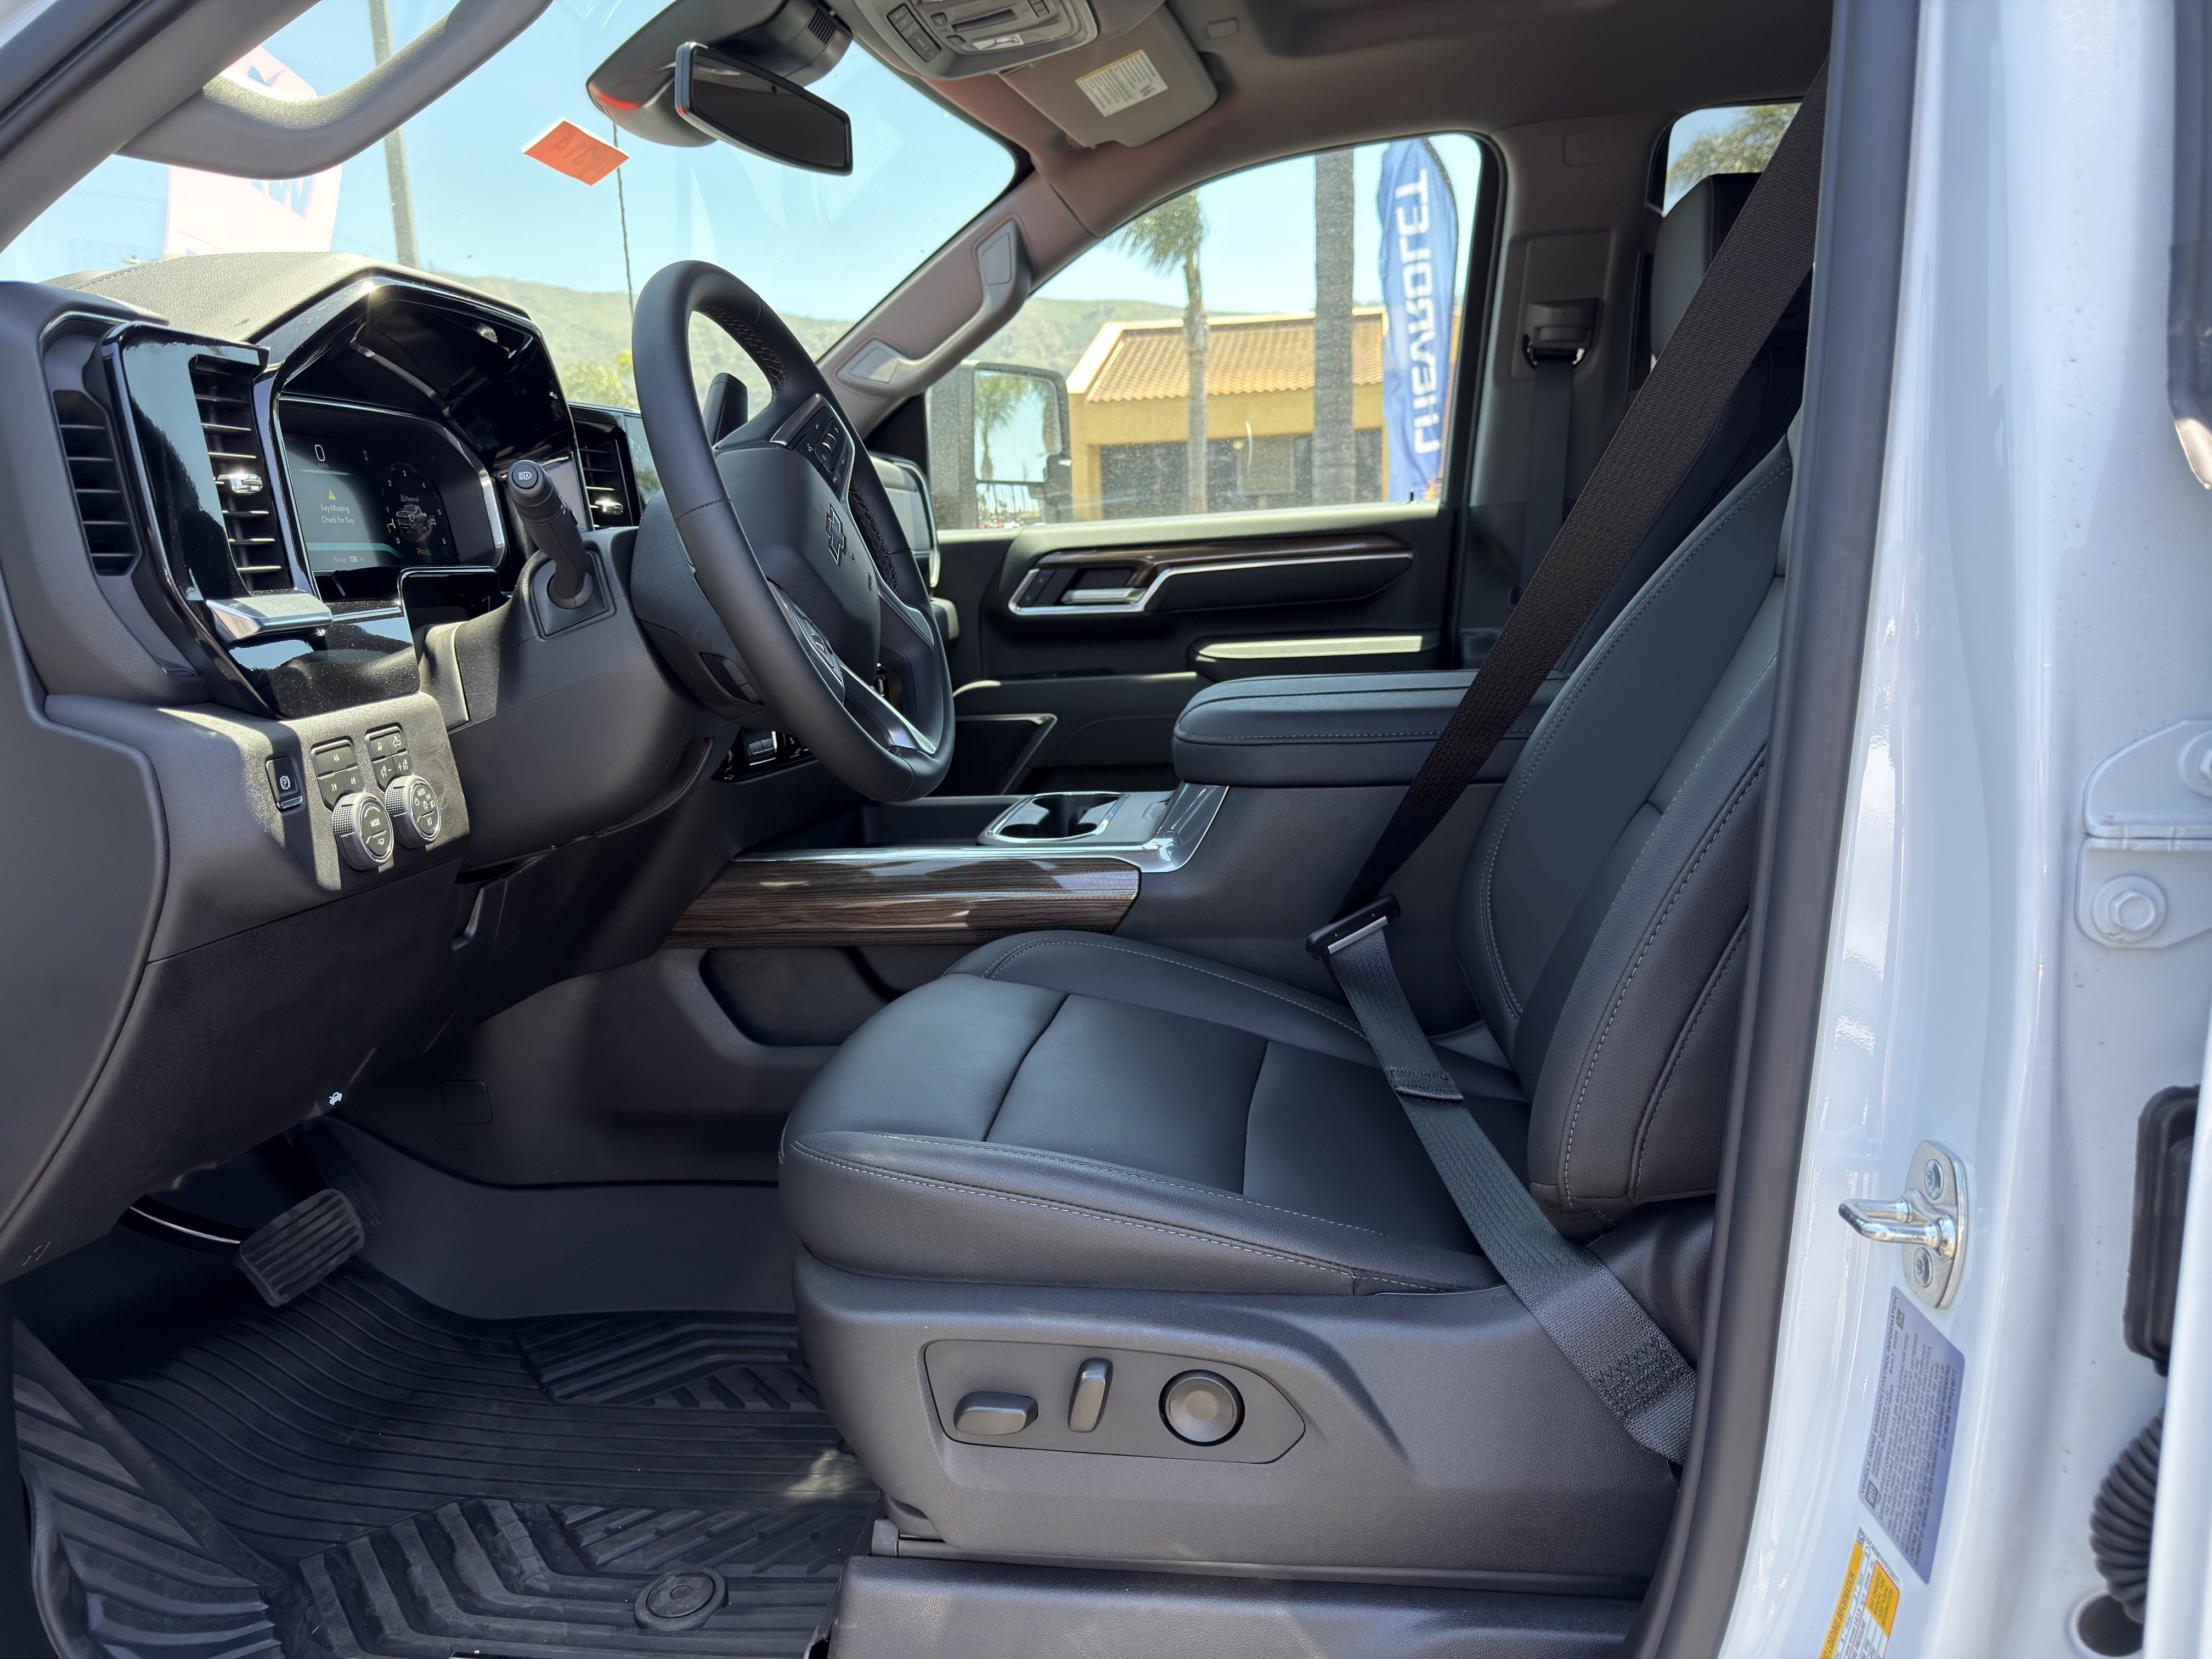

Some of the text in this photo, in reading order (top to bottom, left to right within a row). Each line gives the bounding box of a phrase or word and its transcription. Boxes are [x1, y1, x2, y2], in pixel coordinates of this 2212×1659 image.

[314, 444, 325, 461] 0
[320, 504, 349, 514] Key Missing
[345, 517, 354, 526] Key
[417, 788, 426, 796] AUTO
[370, 818, 381, 828] MODE
[1860, 1294, 1897, 1495] VEHICLE NOISE EMISSION CONTROL INFORMATION
[1871, 1438, 1880, 1475] GENERAL
[1825, 1618, 1839, 1653] LOADING
[1835, 1569, 1855, 1621] INFORMATION
[1854, 1618, 1866, 1651] PRESSURE
